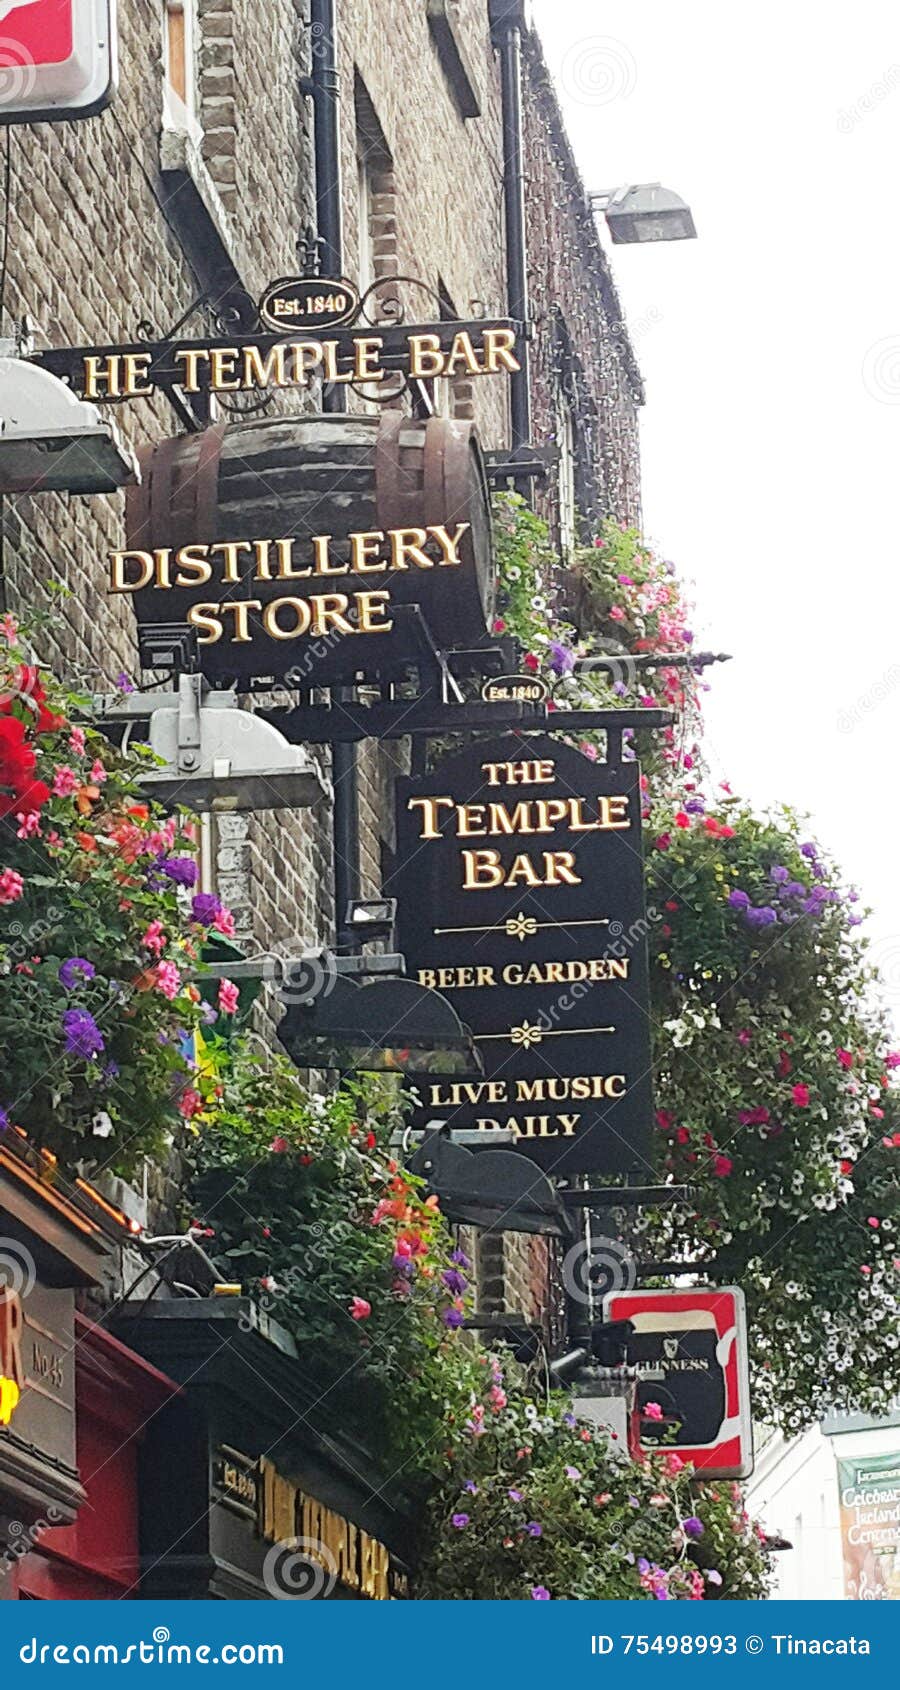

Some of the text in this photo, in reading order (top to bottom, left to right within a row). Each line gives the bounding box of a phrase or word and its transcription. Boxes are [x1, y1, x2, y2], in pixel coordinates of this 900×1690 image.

[273, 294, 347, 316] Est. 1840
[175, 337, 386, 393] TEMPLE
[408, 328, 521, 380] BAR
[108, 522, 470, 593] DISTILLERY
[187, 590, 394, 645] STORE
[512, 685, 540, 699] 1840
[481, 759, 556, 786] THE
[407, 795, 631, 840] TEMPLE
[462, 848, 582, 891] BAR
[417, 957, 630, 989] BEER GARDEN
[429, 1075, 628, 1106] LIVE MUSIC
